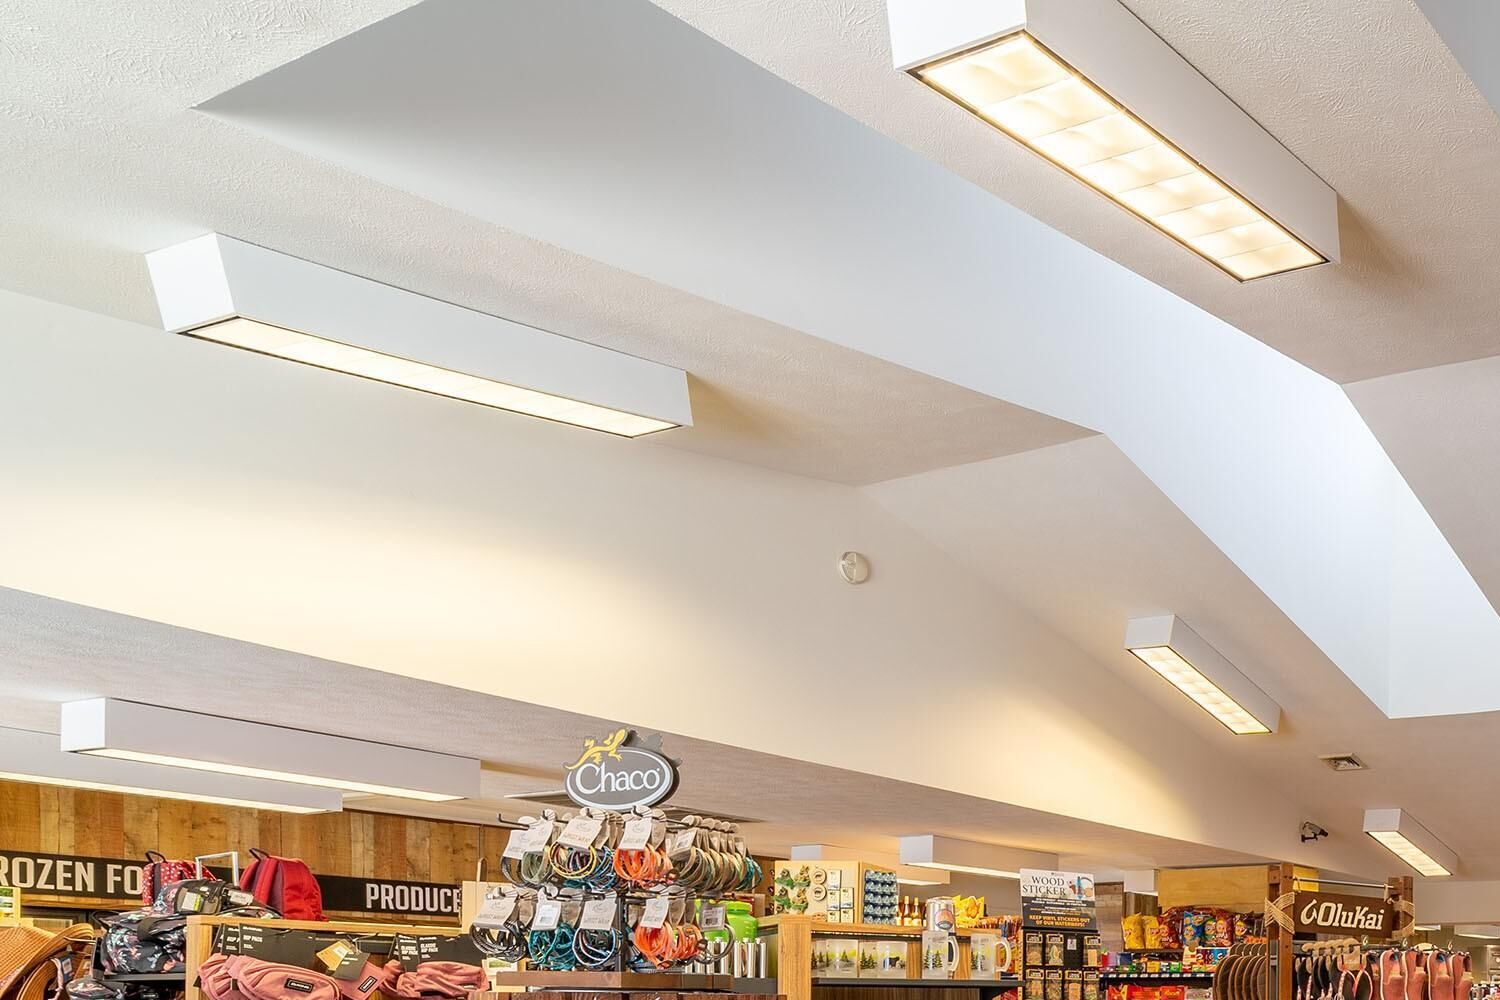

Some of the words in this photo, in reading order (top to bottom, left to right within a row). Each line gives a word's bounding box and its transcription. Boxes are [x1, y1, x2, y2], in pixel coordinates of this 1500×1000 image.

[576, 761, 660, 795] Chaco
[1022, 884, 1066, 896] STICKER
[1032, 875, 1065, 887] WOOD
[366, 883, 461, 913] PRODUCE
[1317, 902, 1385, 930] OluKai
